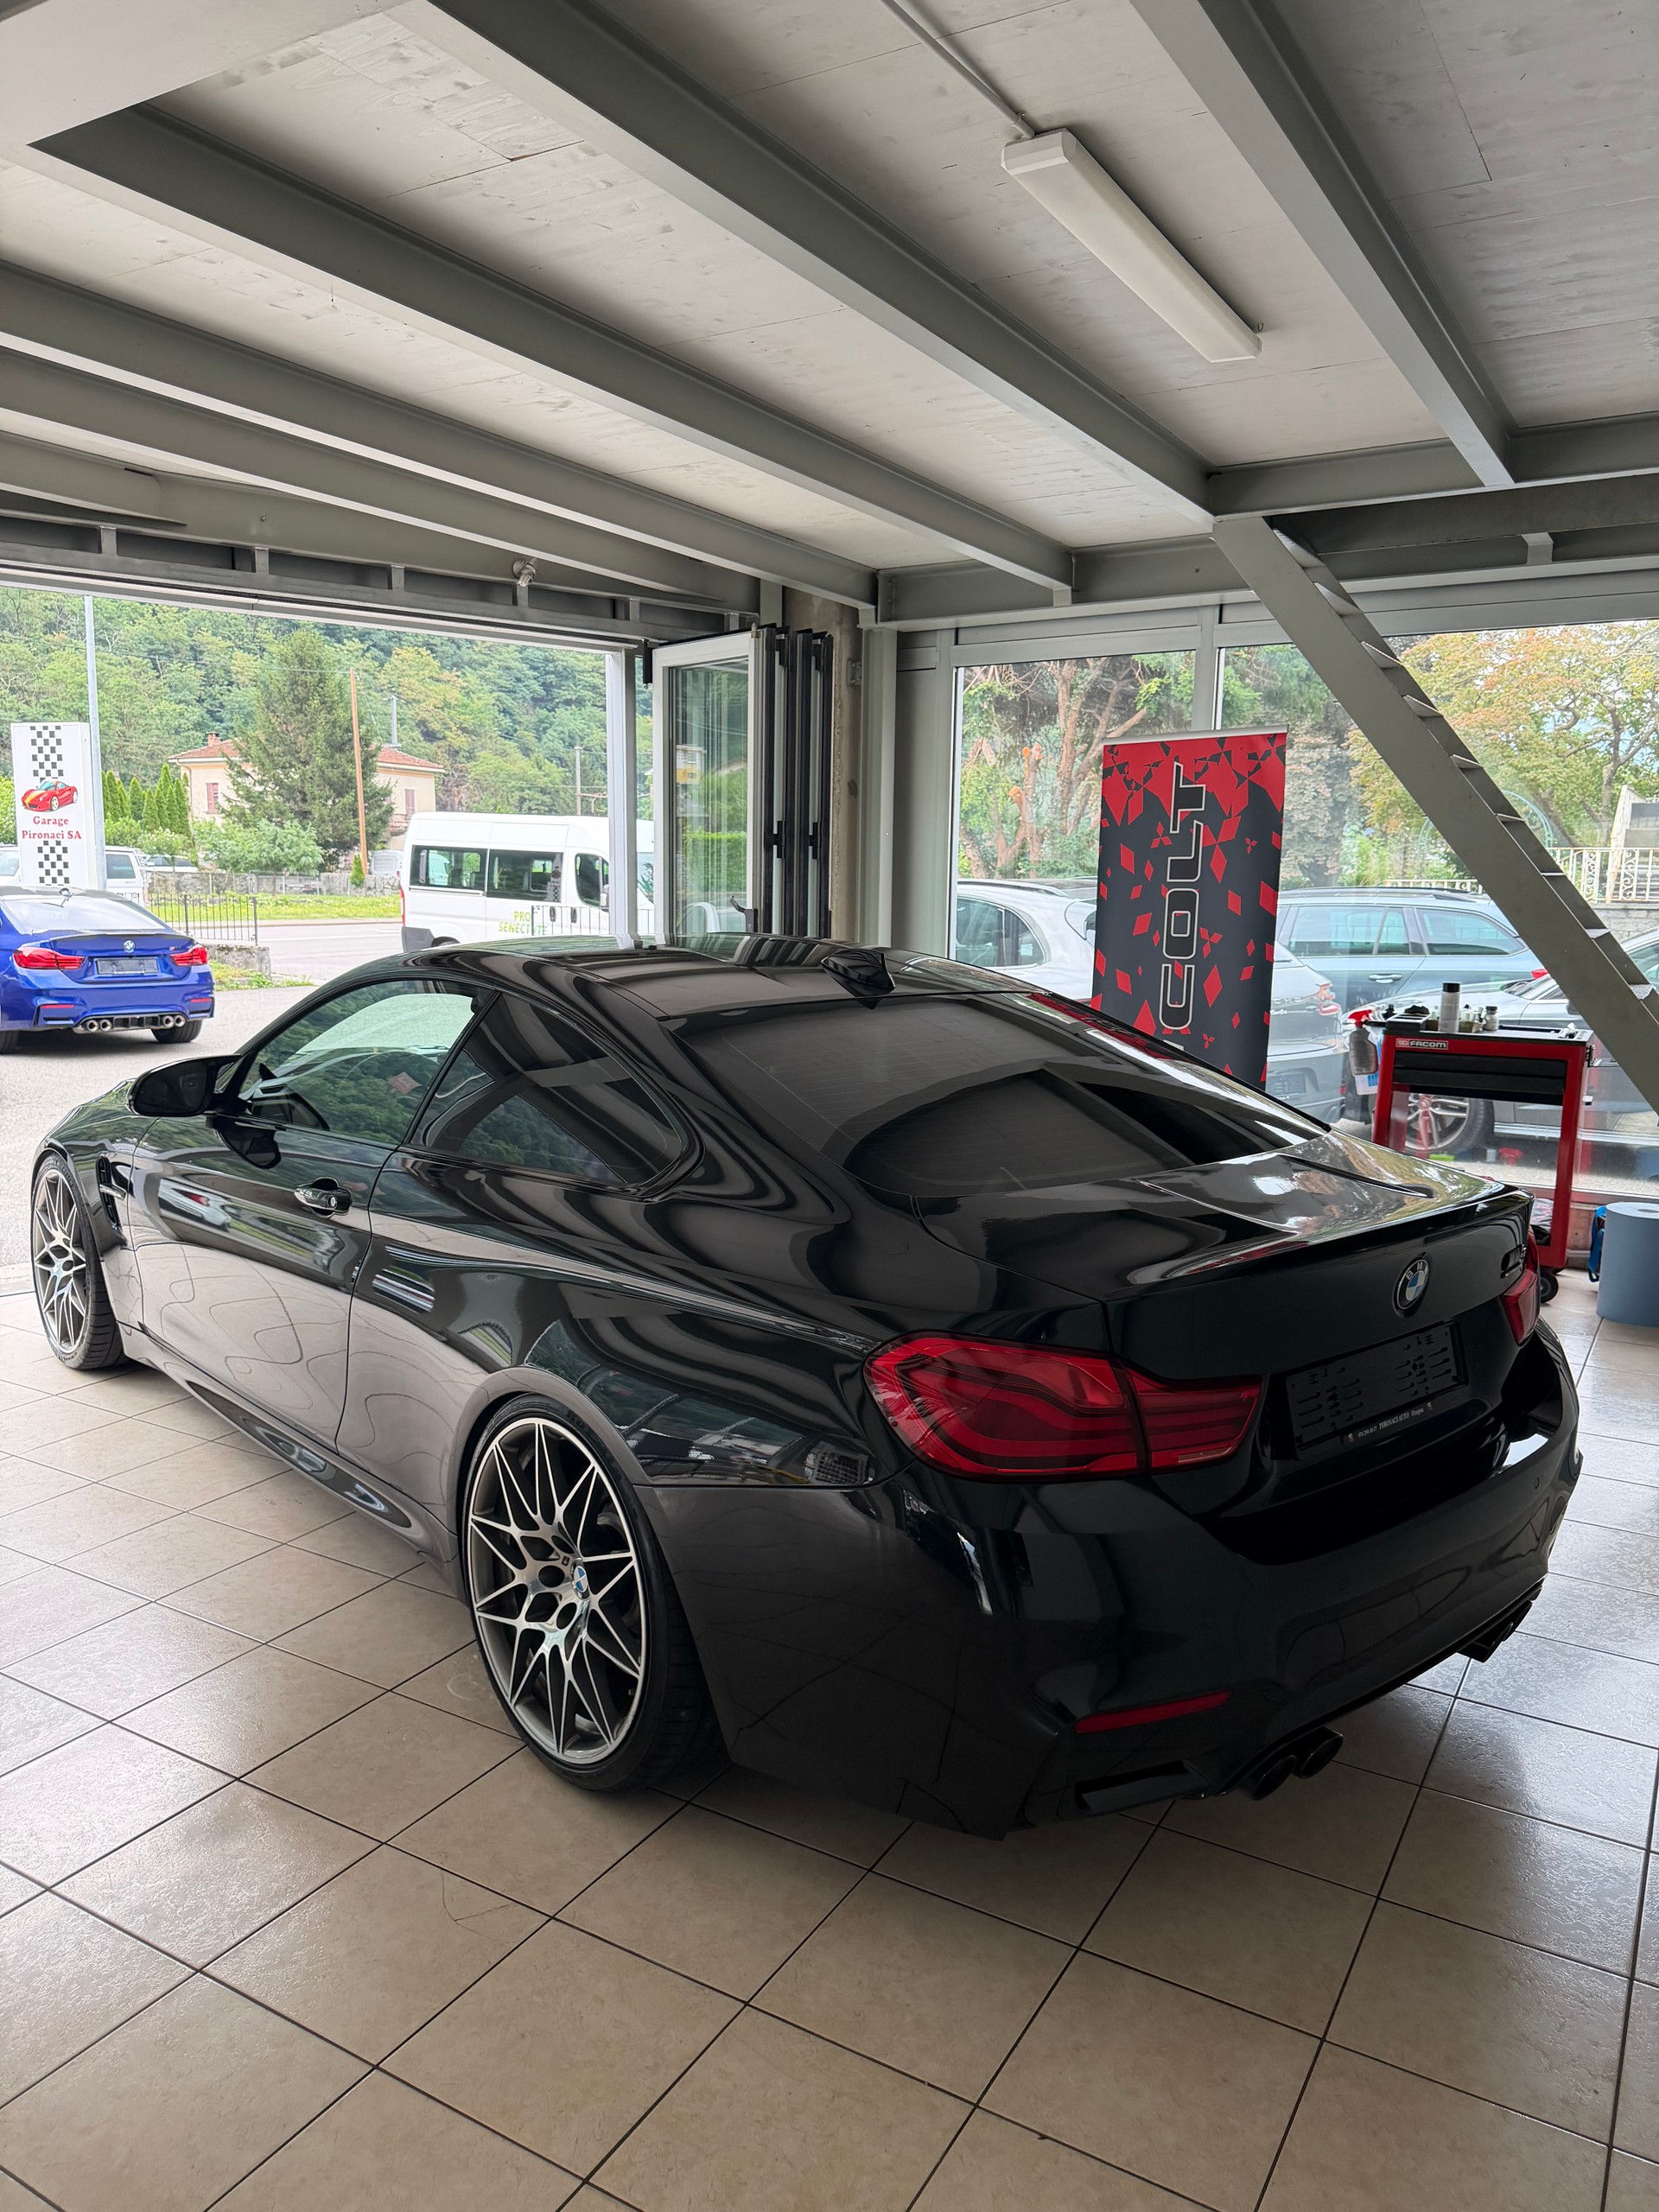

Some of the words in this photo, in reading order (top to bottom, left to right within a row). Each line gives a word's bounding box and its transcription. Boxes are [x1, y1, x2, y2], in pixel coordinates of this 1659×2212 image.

[33, 816, 69, 827] Garage
[22, 830, 65, 839] Pironaci
[67, 830, 82, 839] SA
[1159, 761, 1206, 1030] COLT
[513, 911, 531, 922] PRO
